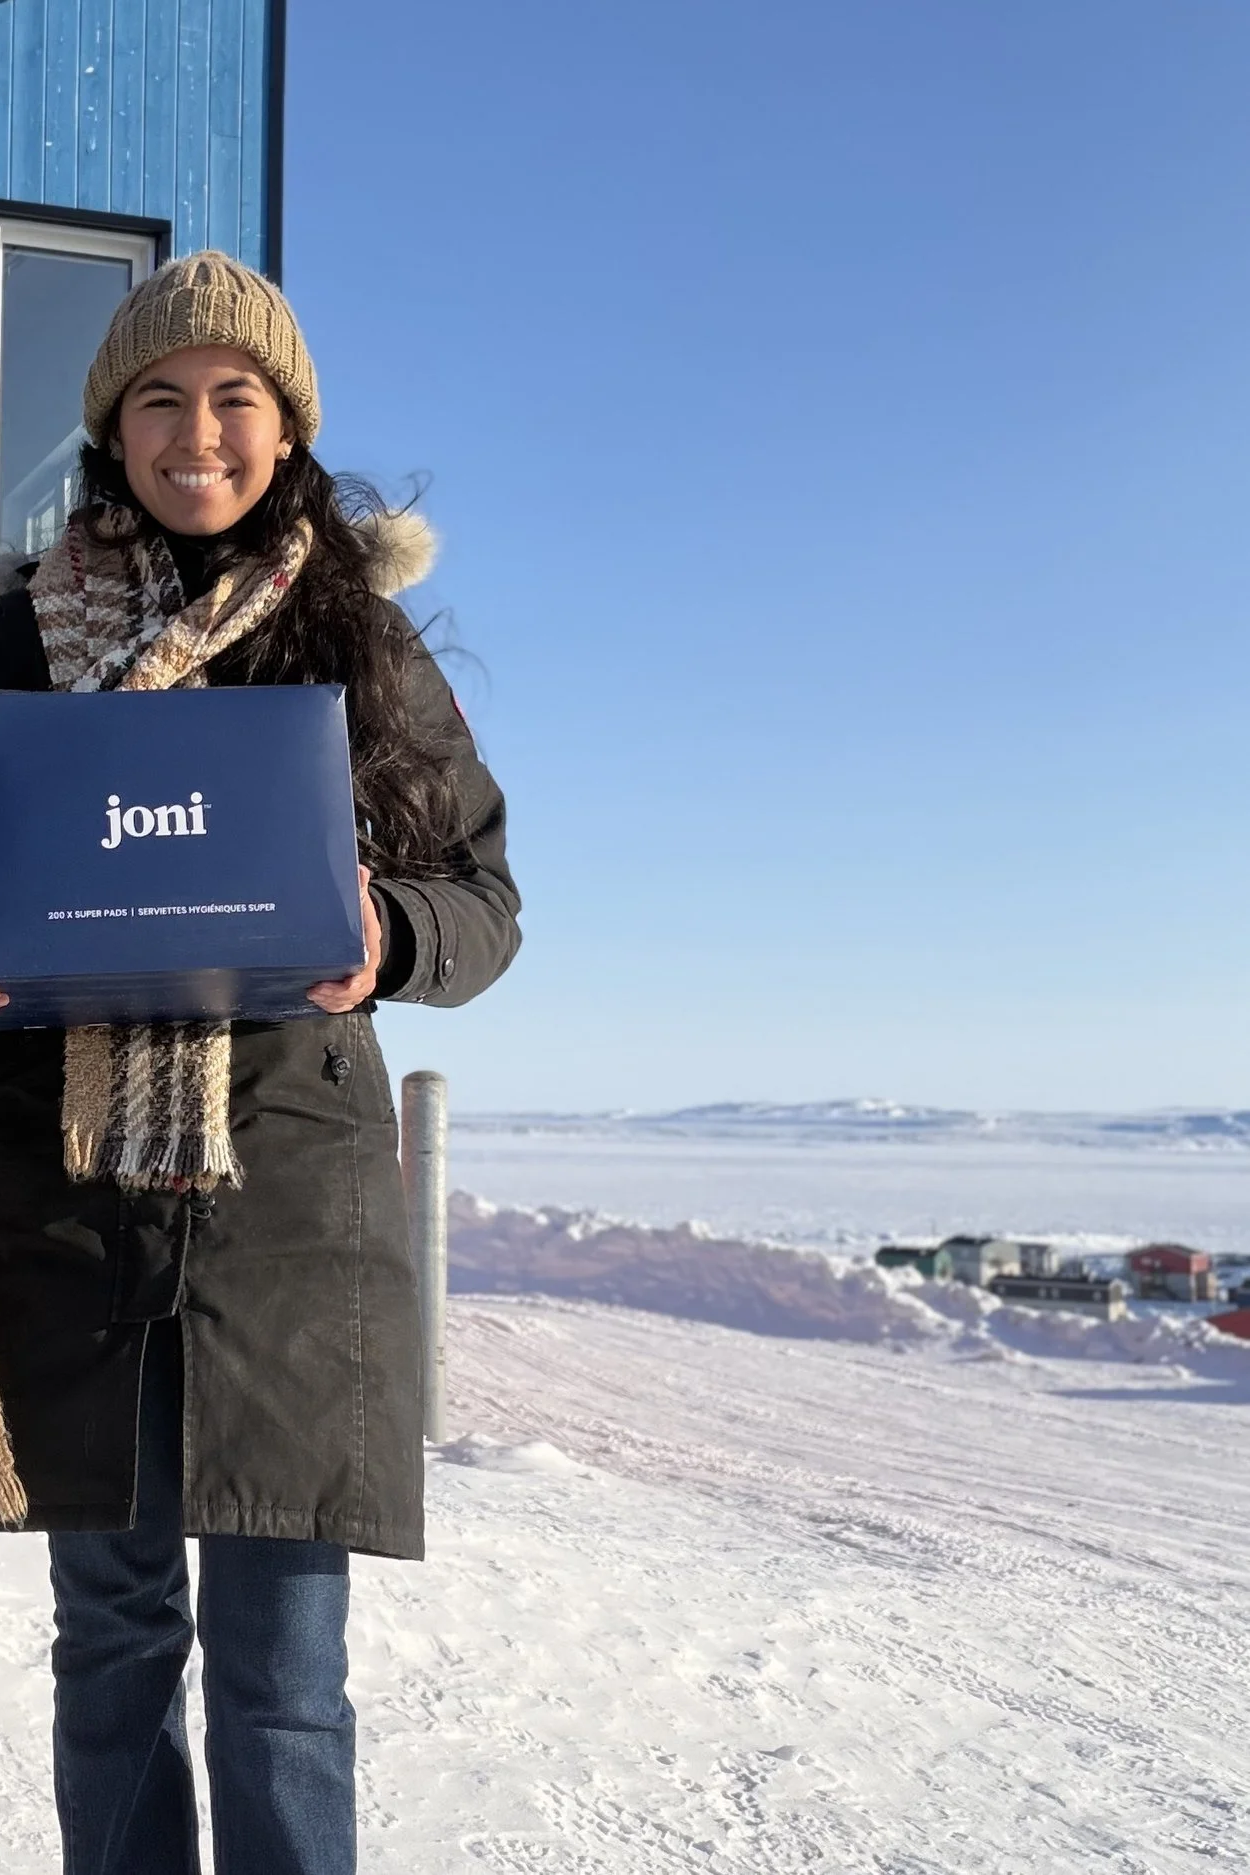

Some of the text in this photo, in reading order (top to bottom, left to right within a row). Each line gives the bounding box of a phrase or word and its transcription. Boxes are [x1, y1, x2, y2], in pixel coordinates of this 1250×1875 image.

[101, 791, 207, 849] joni
[48, 911, 65, 920] 200
[66, 910, 73, 919] X
[74, 909, 102, 919] SUPER
[103, 908, 128, 917] PADS
[138, 906, 188, 916] SERVIETTES
[189, 903, 247, 914] HYGIÉNIQUES
[248, 903, 276, 912] SUPER
